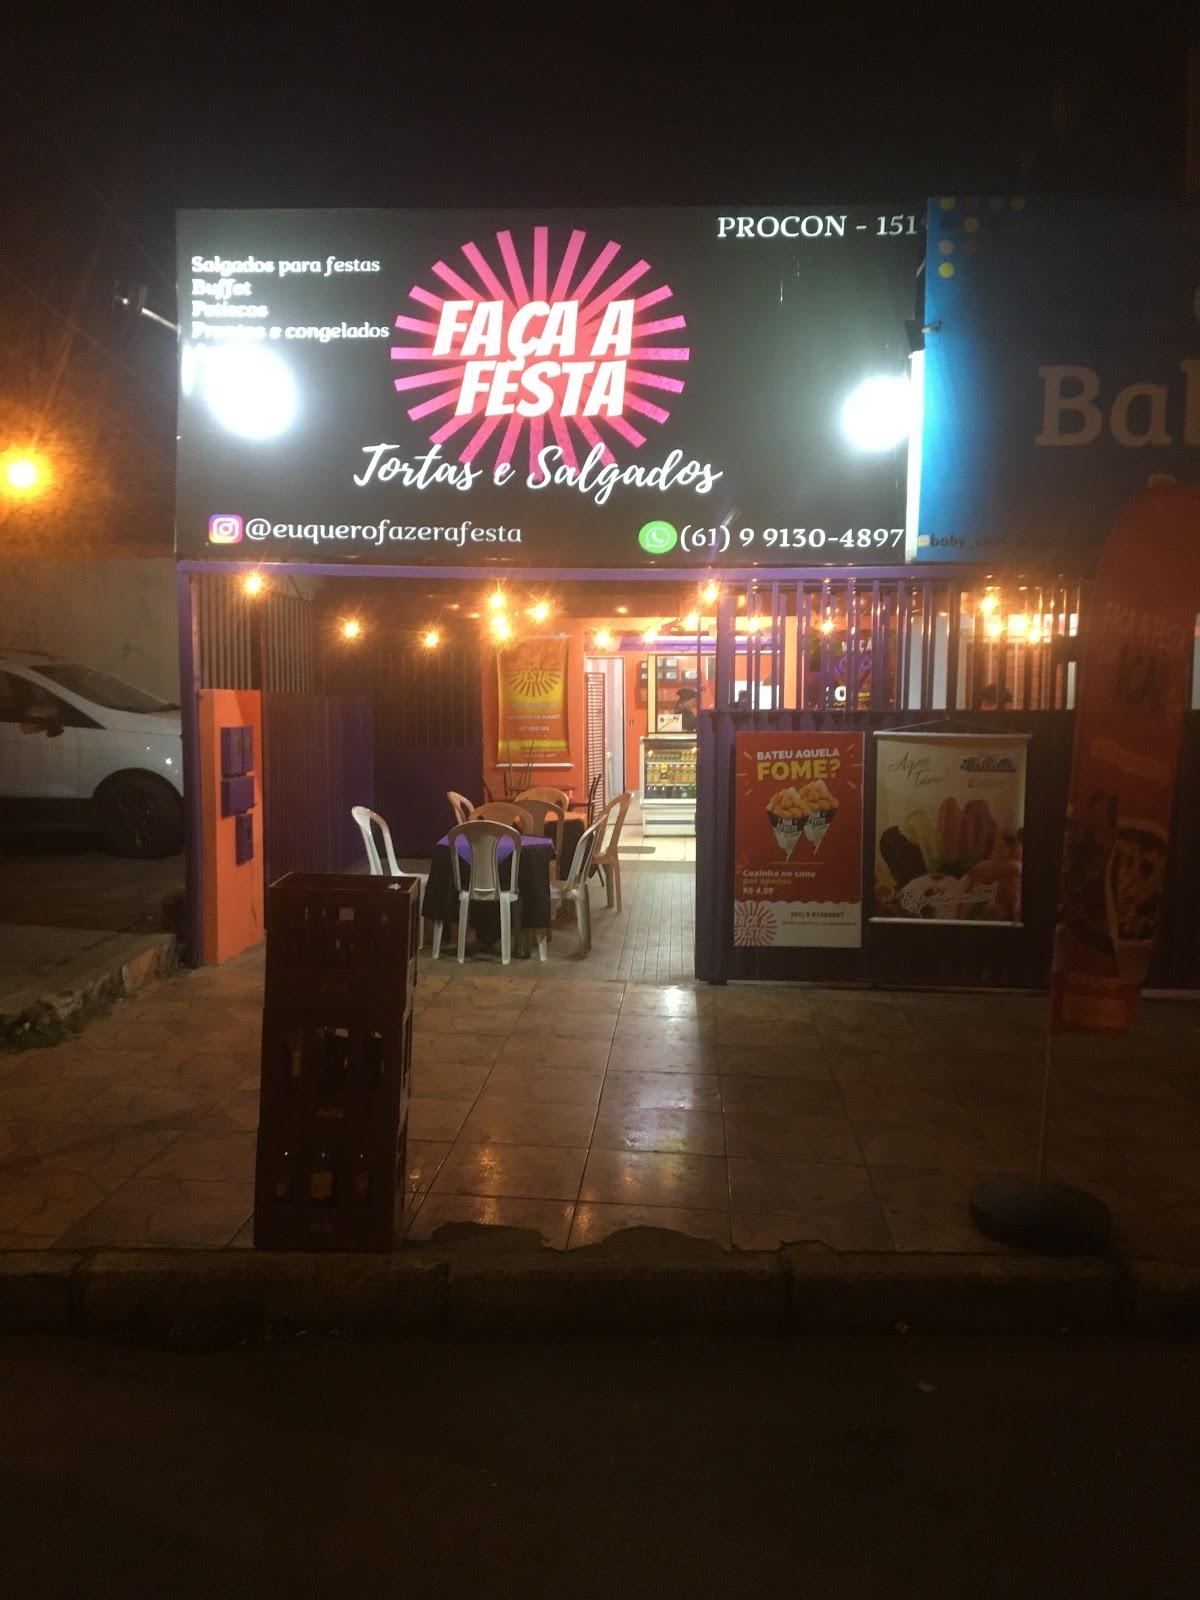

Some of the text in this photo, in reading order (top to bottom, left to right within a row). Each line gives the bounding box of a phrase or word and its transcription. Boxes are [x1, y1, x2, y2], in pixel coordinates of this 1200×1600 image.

[718, 216, 847, 237] PROCON
[876, 214, 915, 236] 151
[191, 255, 381, 277] Salgados para festas
[191, 279, 252, 300] Buffet
[285, 322, 389, 342] congelados
[432, 298, 635, 367] FAÇA A
[454, 359, 627, 418] FESTA
[353, 442, 723, 504] Tortas e Salgados
[246, 517, 522, 547] @euquerofazerafesta
[680, 525, 904, 553] (61) 9 9130-4897
[756, 747, 840, 761] BATEU AQUELA
[756, 758, 841, 781] FOME?
[742, 868, 779, 878] Coxinha
